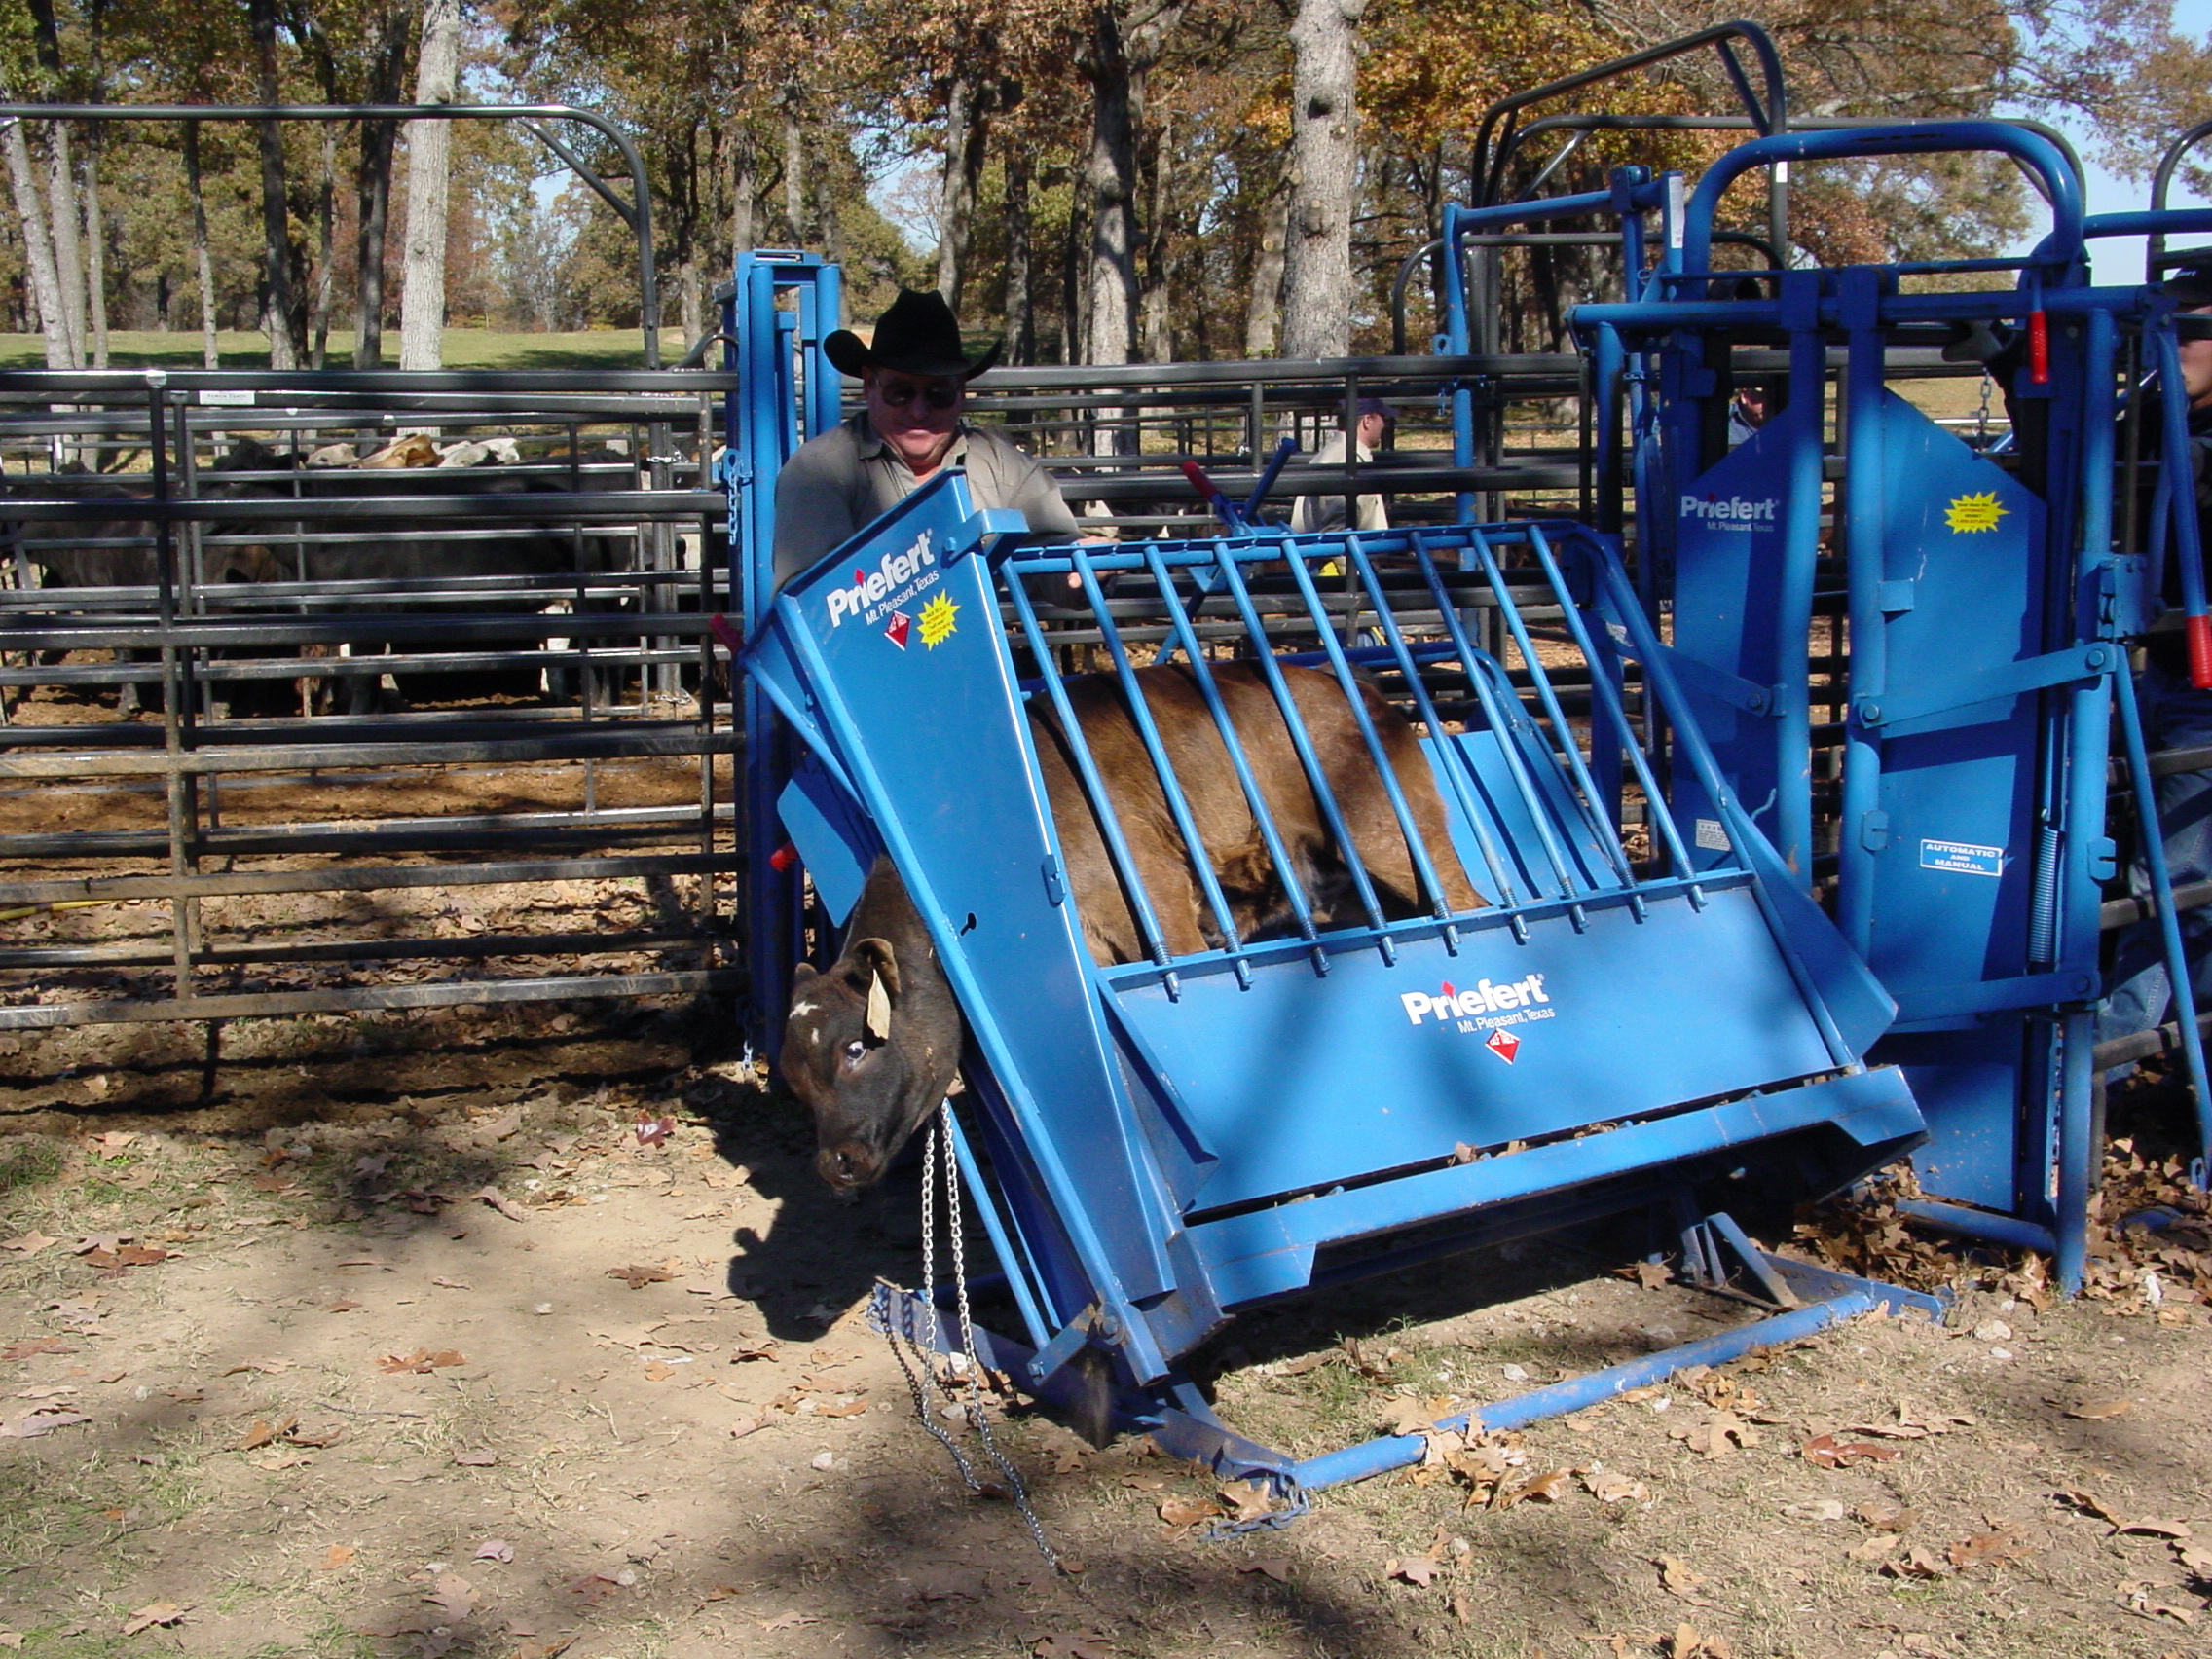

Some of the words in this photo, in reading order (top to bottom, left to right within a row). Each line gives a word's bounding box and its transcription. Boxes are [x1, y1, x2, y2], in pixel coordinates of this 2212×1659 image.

[1680, 493, 1775, 520] Priefert
[827, 532, 936, 628] Priefert
[866, 609, 880, 626] Mt.
[913, 570, 940, 592] Texas
[1926, 843, 1996, 858] AUTOMATIC
[1935, 858, 1985, 871] MANUAL
[1400, 973, 1550, 1026] Priefert
[1456, 1019, 1478, 1034] Mt.
[1522, 1008, 1556, 1021] Texas
